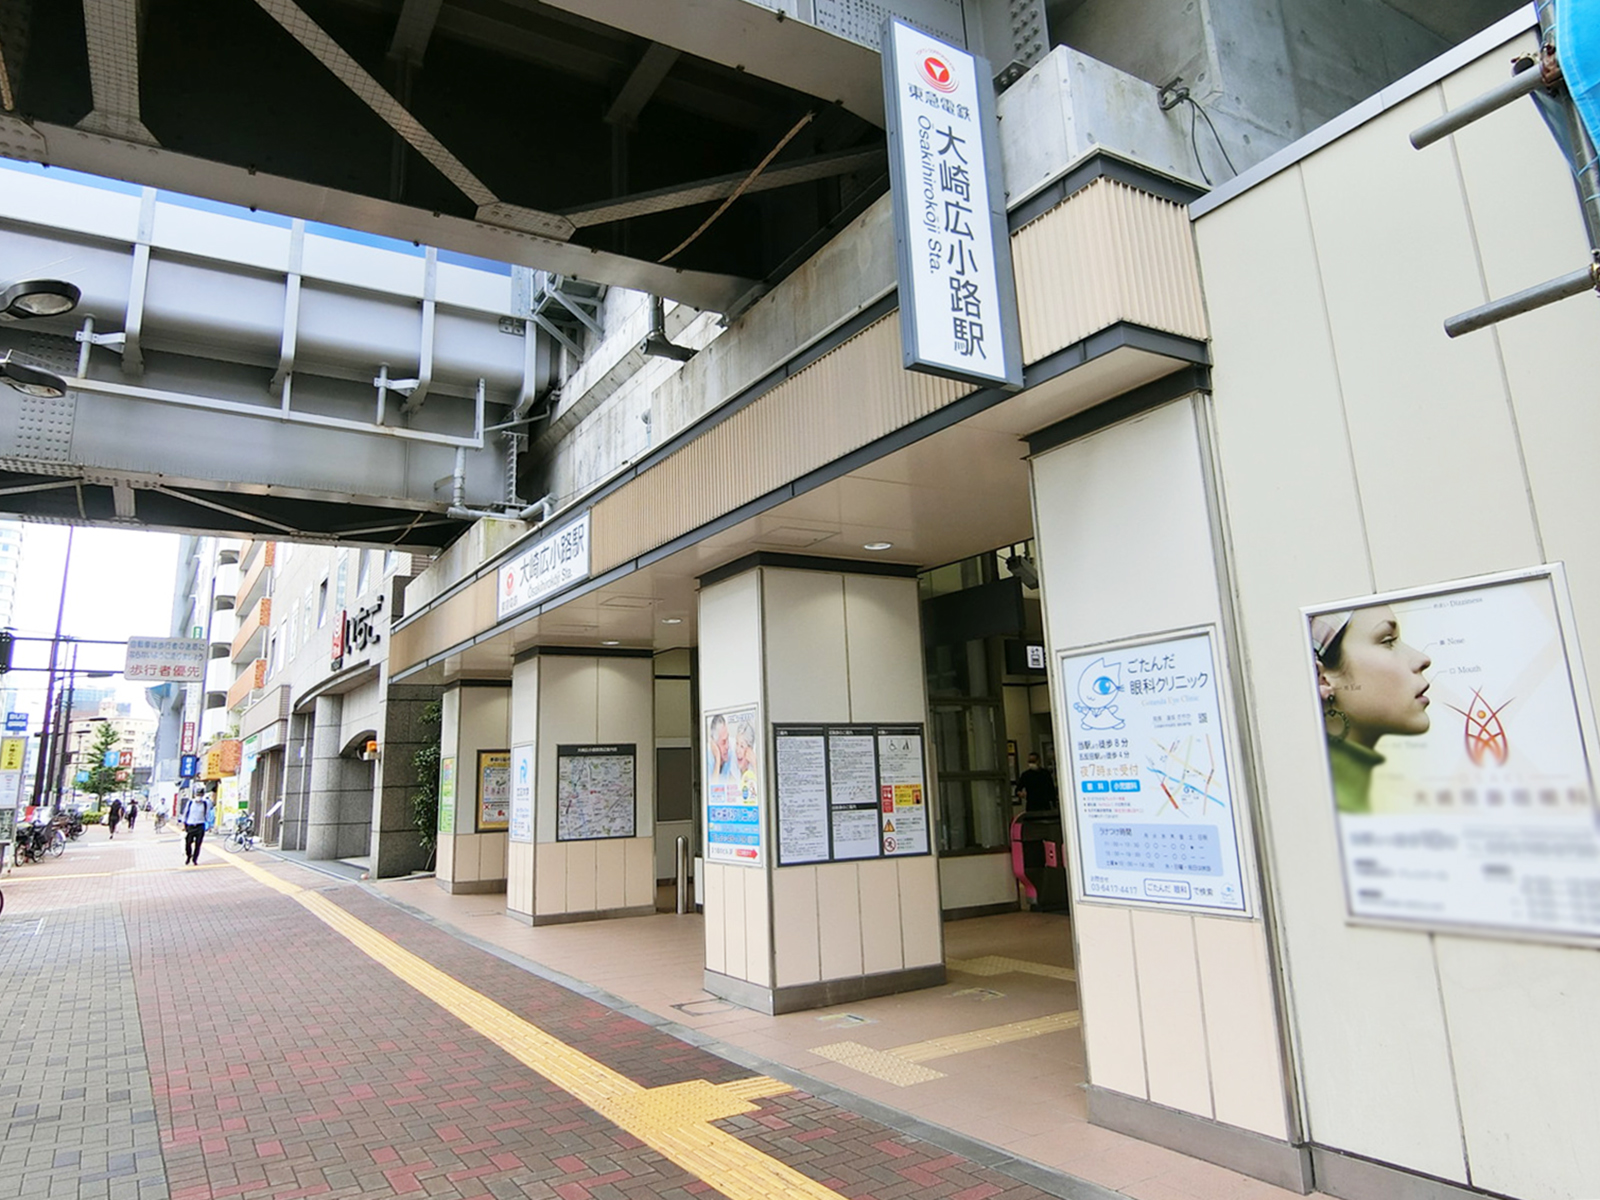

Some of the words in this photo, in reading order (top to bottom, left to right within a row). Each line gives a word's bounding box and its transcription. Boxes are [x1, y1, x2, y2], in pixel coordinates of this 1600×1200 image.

[907, 82, 971, 122] 東急電鉄
[937, 125, 987, 360] 大崎広小路駅
[927, 239, 943, 274] Sta.
[519, 523, 585, 587] 大崎広小路駅
[1449, 596, 1483, 607] Dizziness
[1447, 637, 1465, 646] Nose
[129, 664, 200, 678] 歩行者優先
[1127, 654, 1176, 674] ごたんだ
[1458, 664, 1482, 674] Mouth
[1129, 672, 1209, 696] 眼科クリニック
[1080, 763, 1138, 777] 夜7時まで受付
[1099, 827, 1132, 837] うけつけ時間
[1147, 883, 1172, 894] ごたんだ
